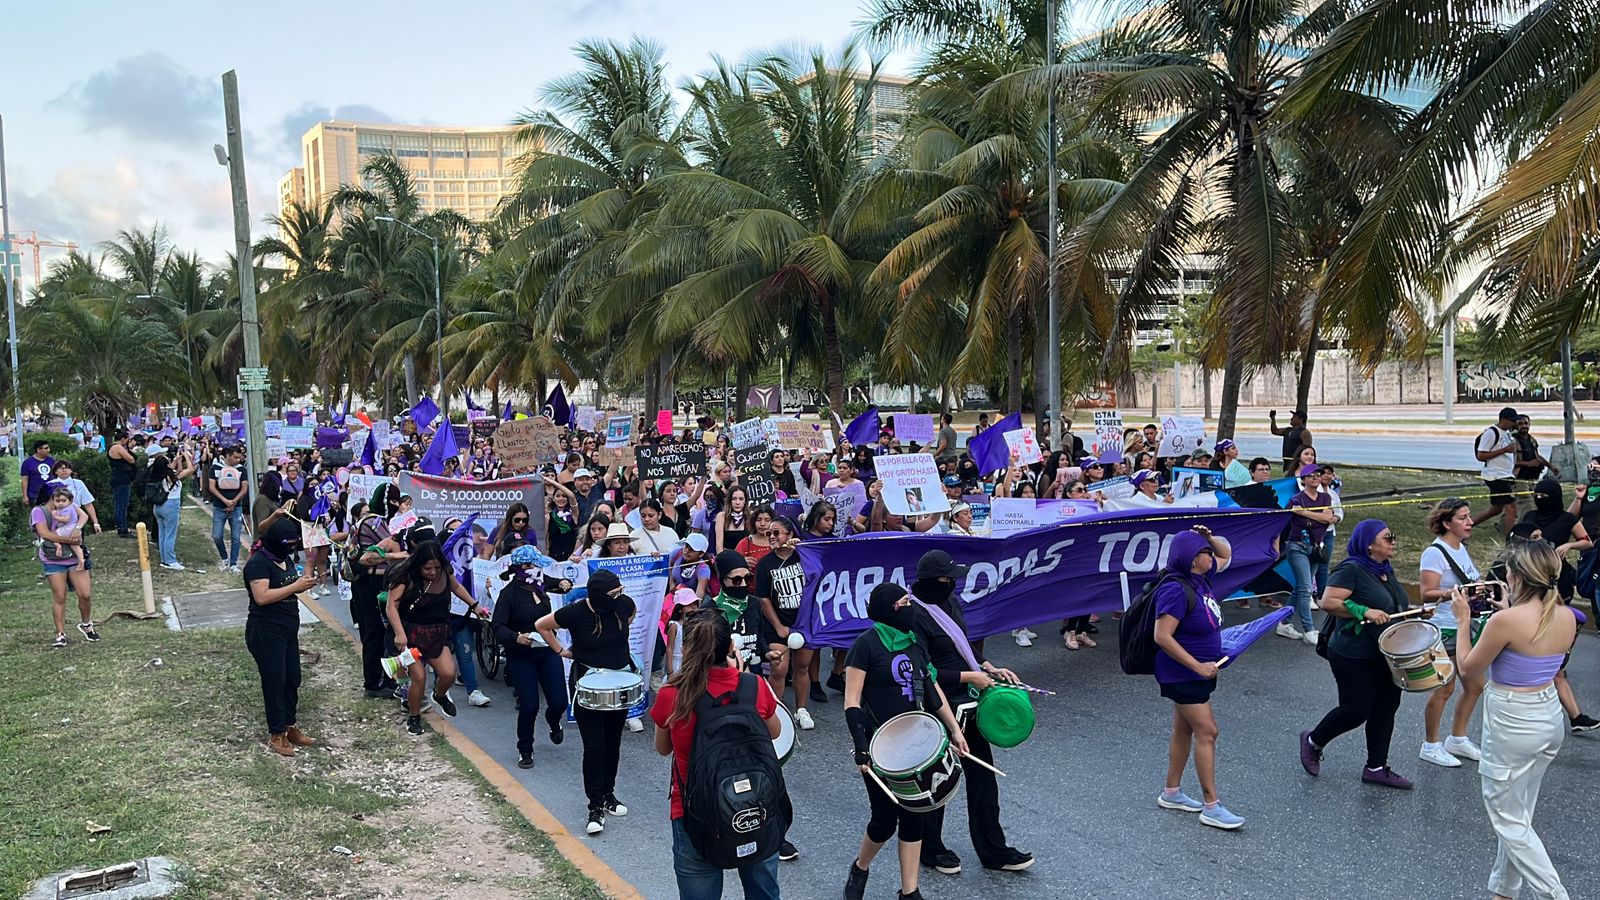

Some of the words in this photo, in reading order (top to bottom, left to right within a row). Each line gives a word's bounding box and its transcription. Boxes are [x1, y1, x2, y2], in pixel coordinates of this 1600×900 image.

[1095, 411, 1117, 419] ESTAR
[1102, 433, 1120, 441] VIVA
[497, 439, 530, 449] LLANTOS
[641, 448, 651, 458] NO
[657, 443, 704, 456] APARECEMOS
[651, 455, 687, 465] MUERTAS
[876, 458, 887, 467] ES
[887, 457, 902, 465] POR
[902, 456, 919, 465] ELLA
[919, 455, 933, 465] QUE
[647, 468, 665, 477] NOS
[670, 464, 699, 476] MATAN
[879, 469, 894, 479] HOY
[895, 468, 916, 477] GRITO
[917, 467, 938, 475] HASTA
[906, 477, 927, 486] CIELO
[421, 489, 437, 500] De
[440, 488, 448, 501] $
[450, 490, 523, 502] 1,000,000.00
[955, 539, 1075, 604] ODAS
